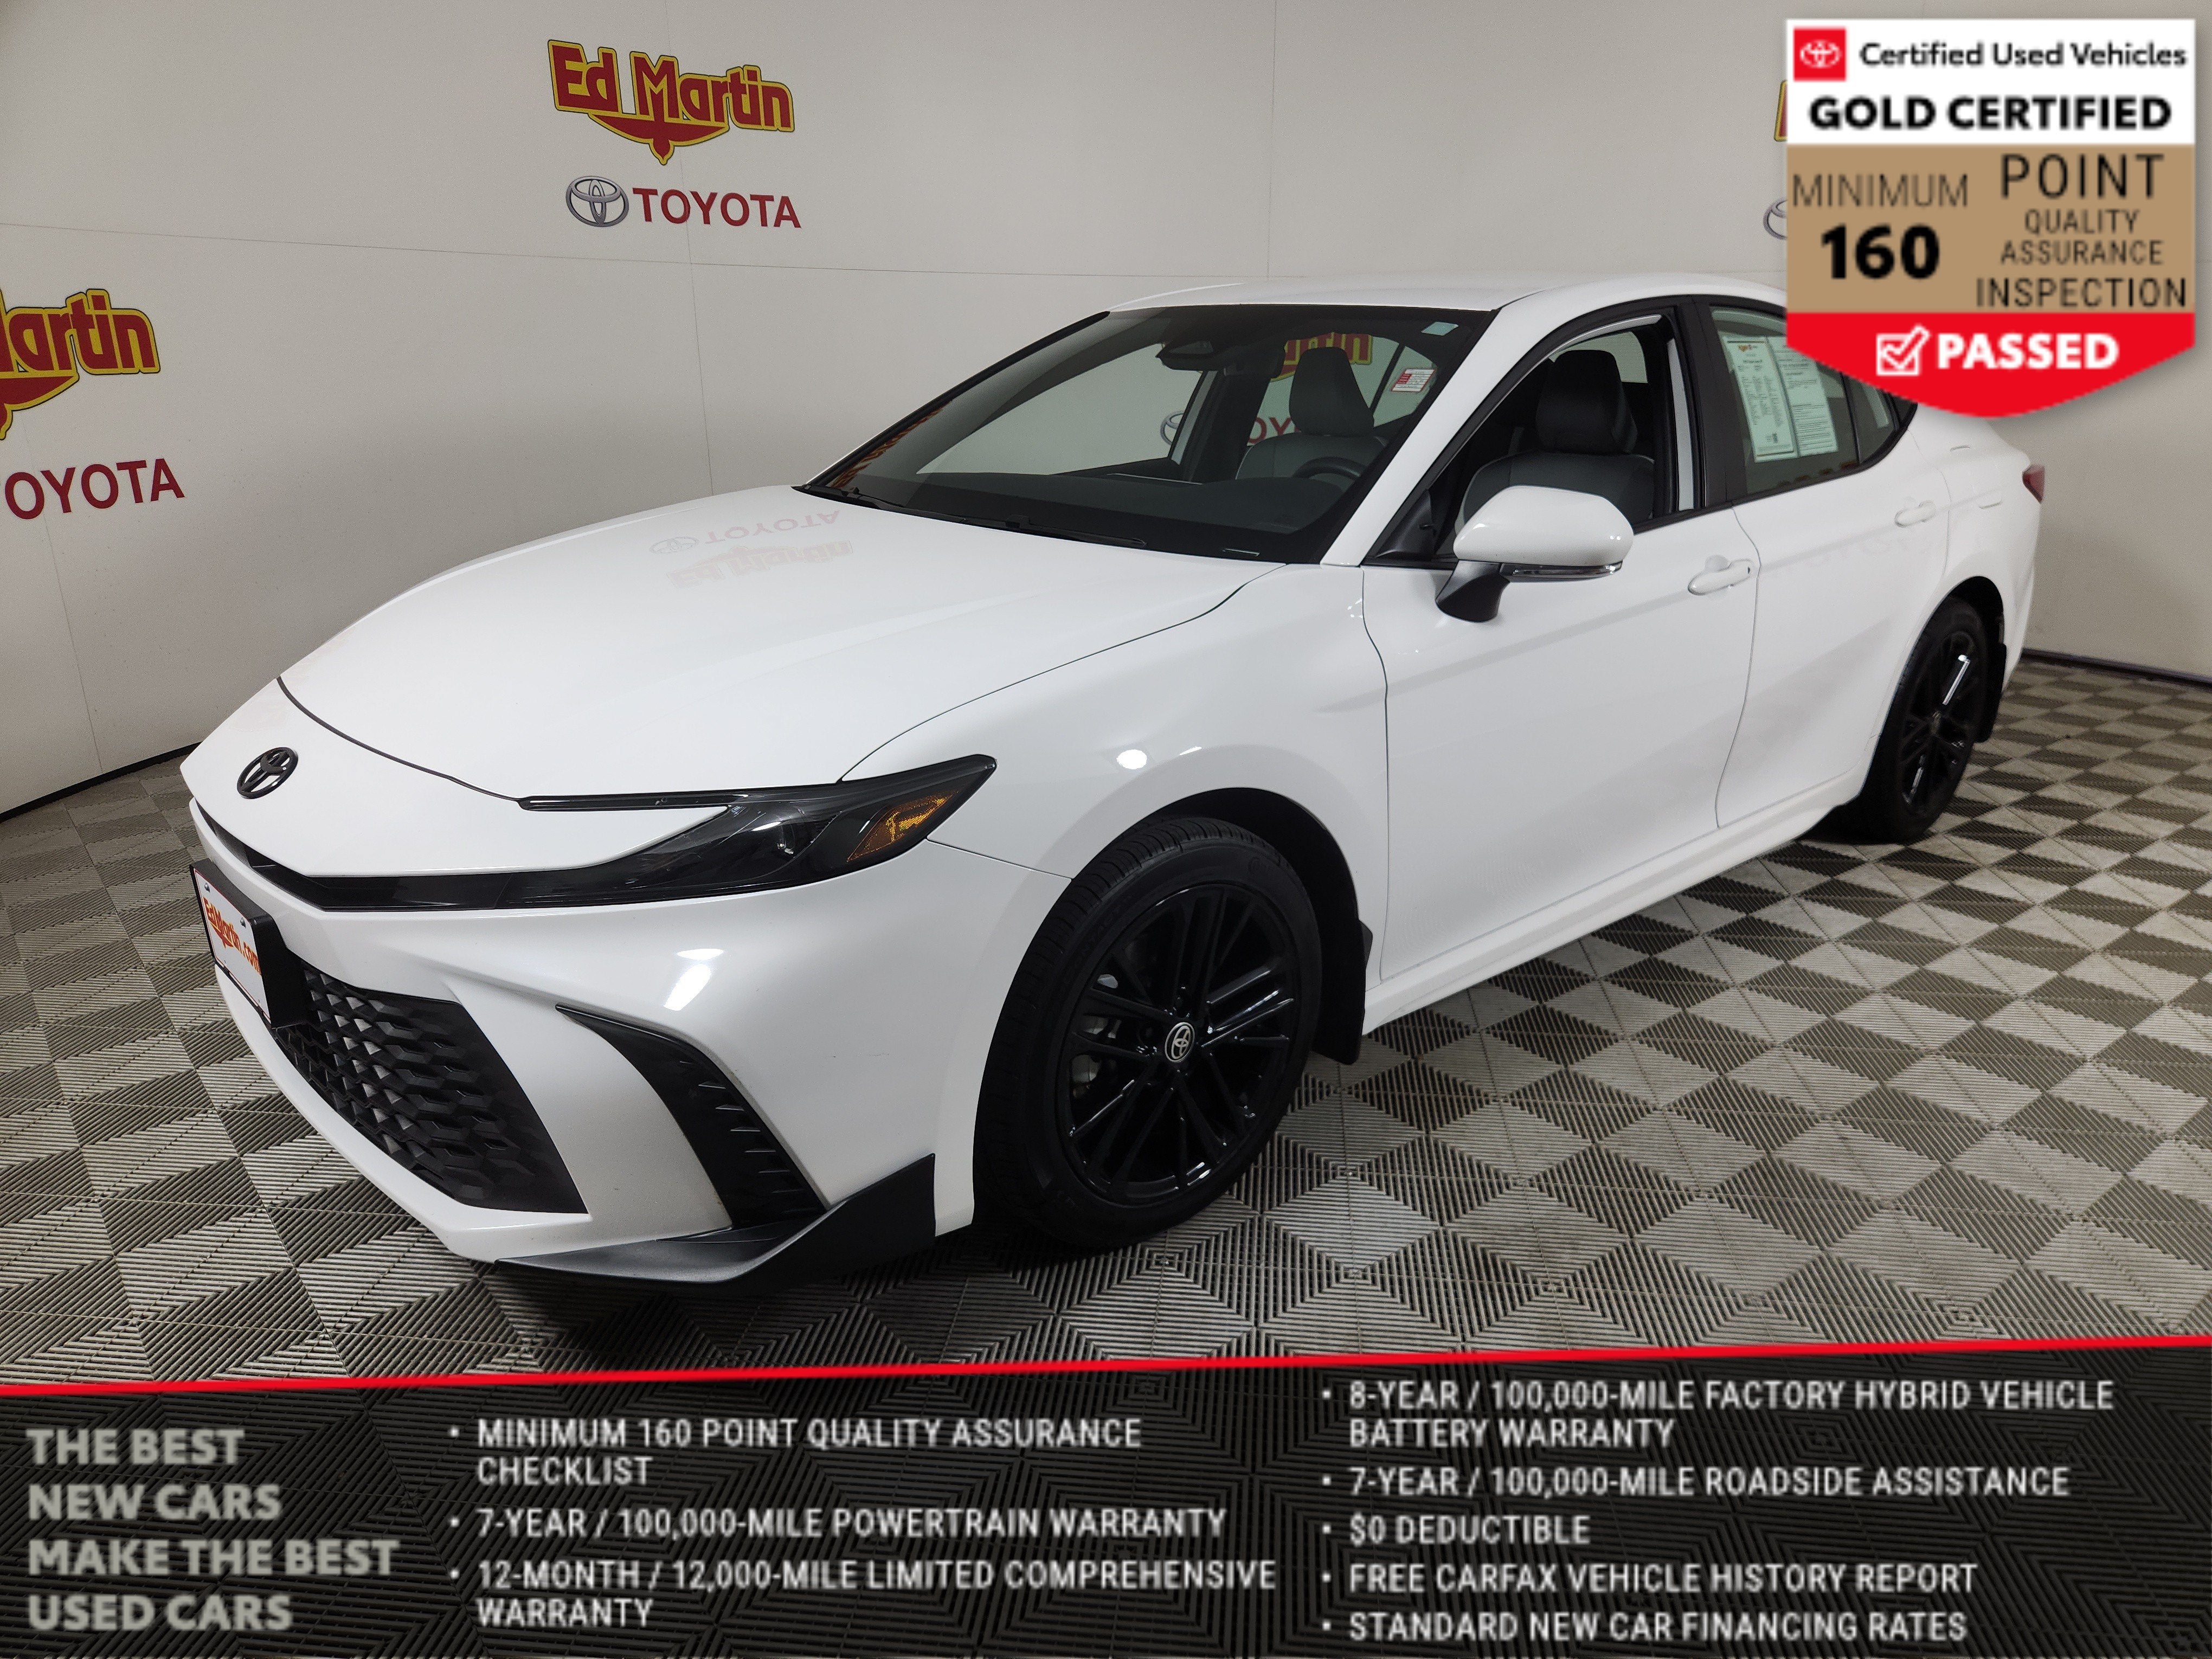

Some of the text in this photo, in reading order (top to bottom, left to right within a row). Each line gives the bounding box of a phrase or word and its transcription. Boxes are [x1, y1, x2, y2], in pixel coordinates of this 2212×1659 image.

[548, 41, 794, 132] Ed Martin
[632, 187, 802, 228] TOYOTA
[0, 289, 160, 375] artin
